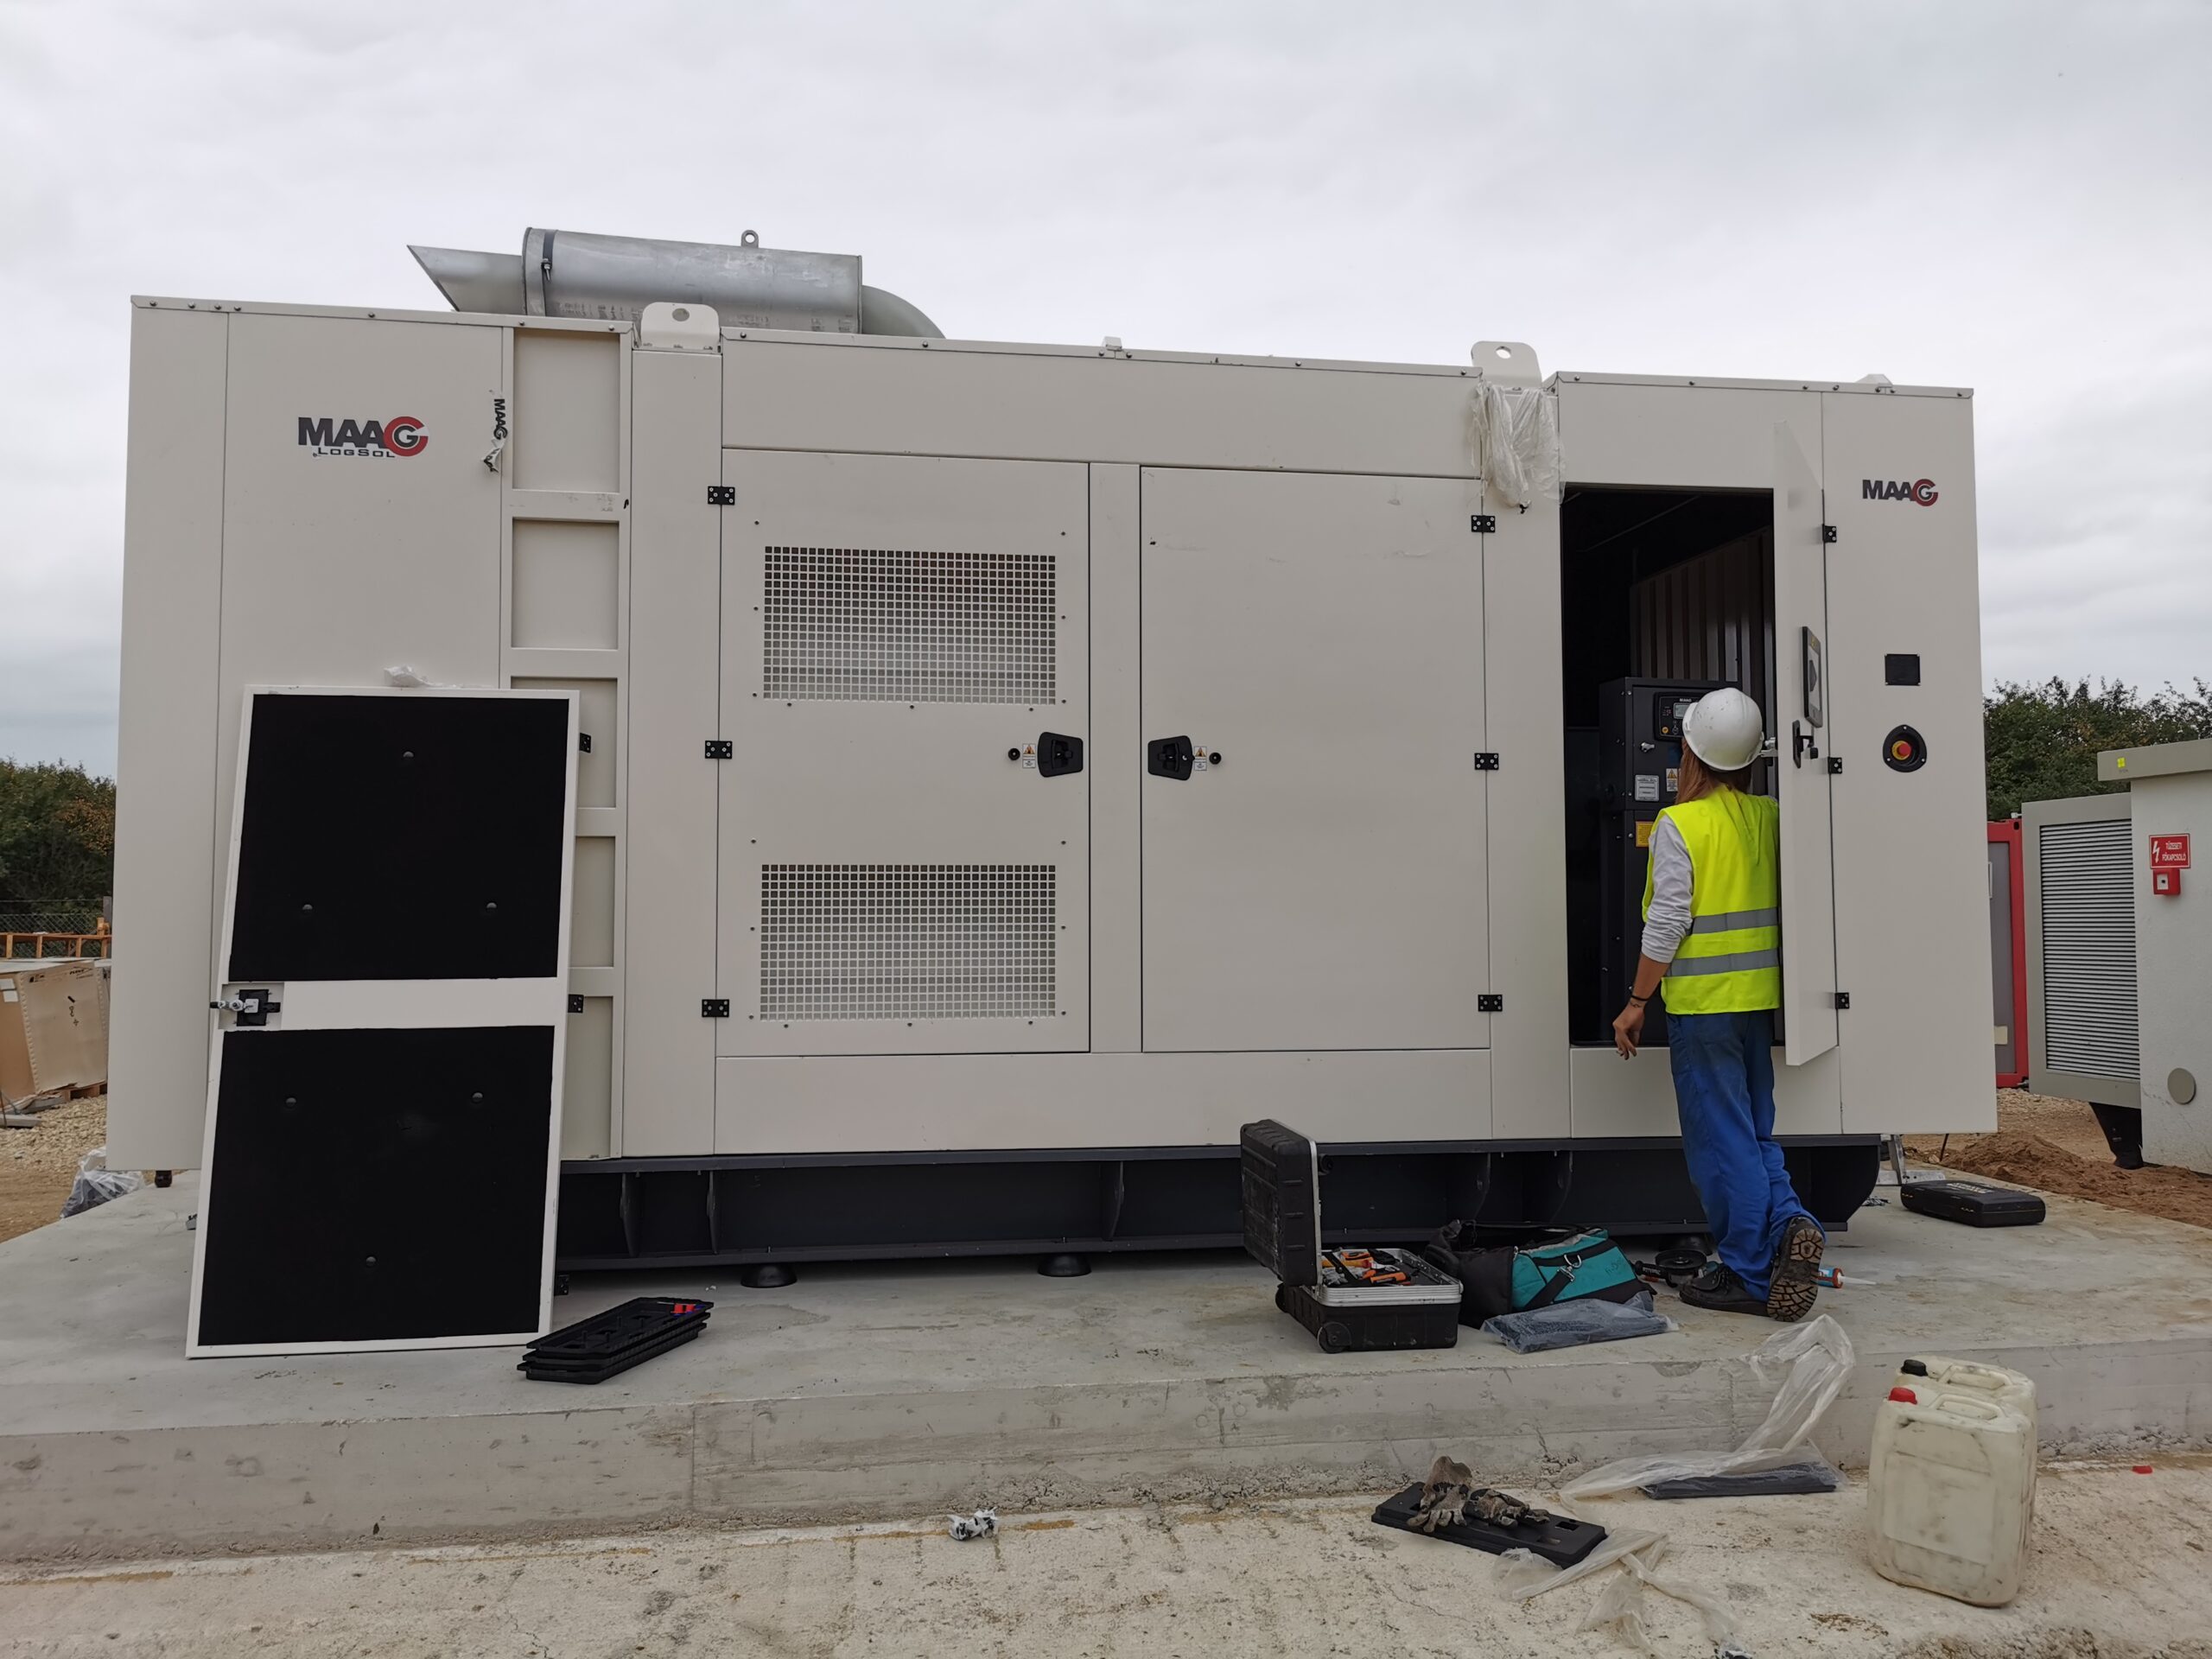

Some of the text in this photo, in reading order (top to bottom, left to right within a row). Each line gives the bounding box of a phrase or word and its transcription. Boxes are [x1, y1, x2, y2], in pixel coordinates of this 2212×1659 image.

[298, 416, 429, 457] MAAG
[493, 399, 508, 440] MAAG
[1862, 479, 1939, 506] MAAG
